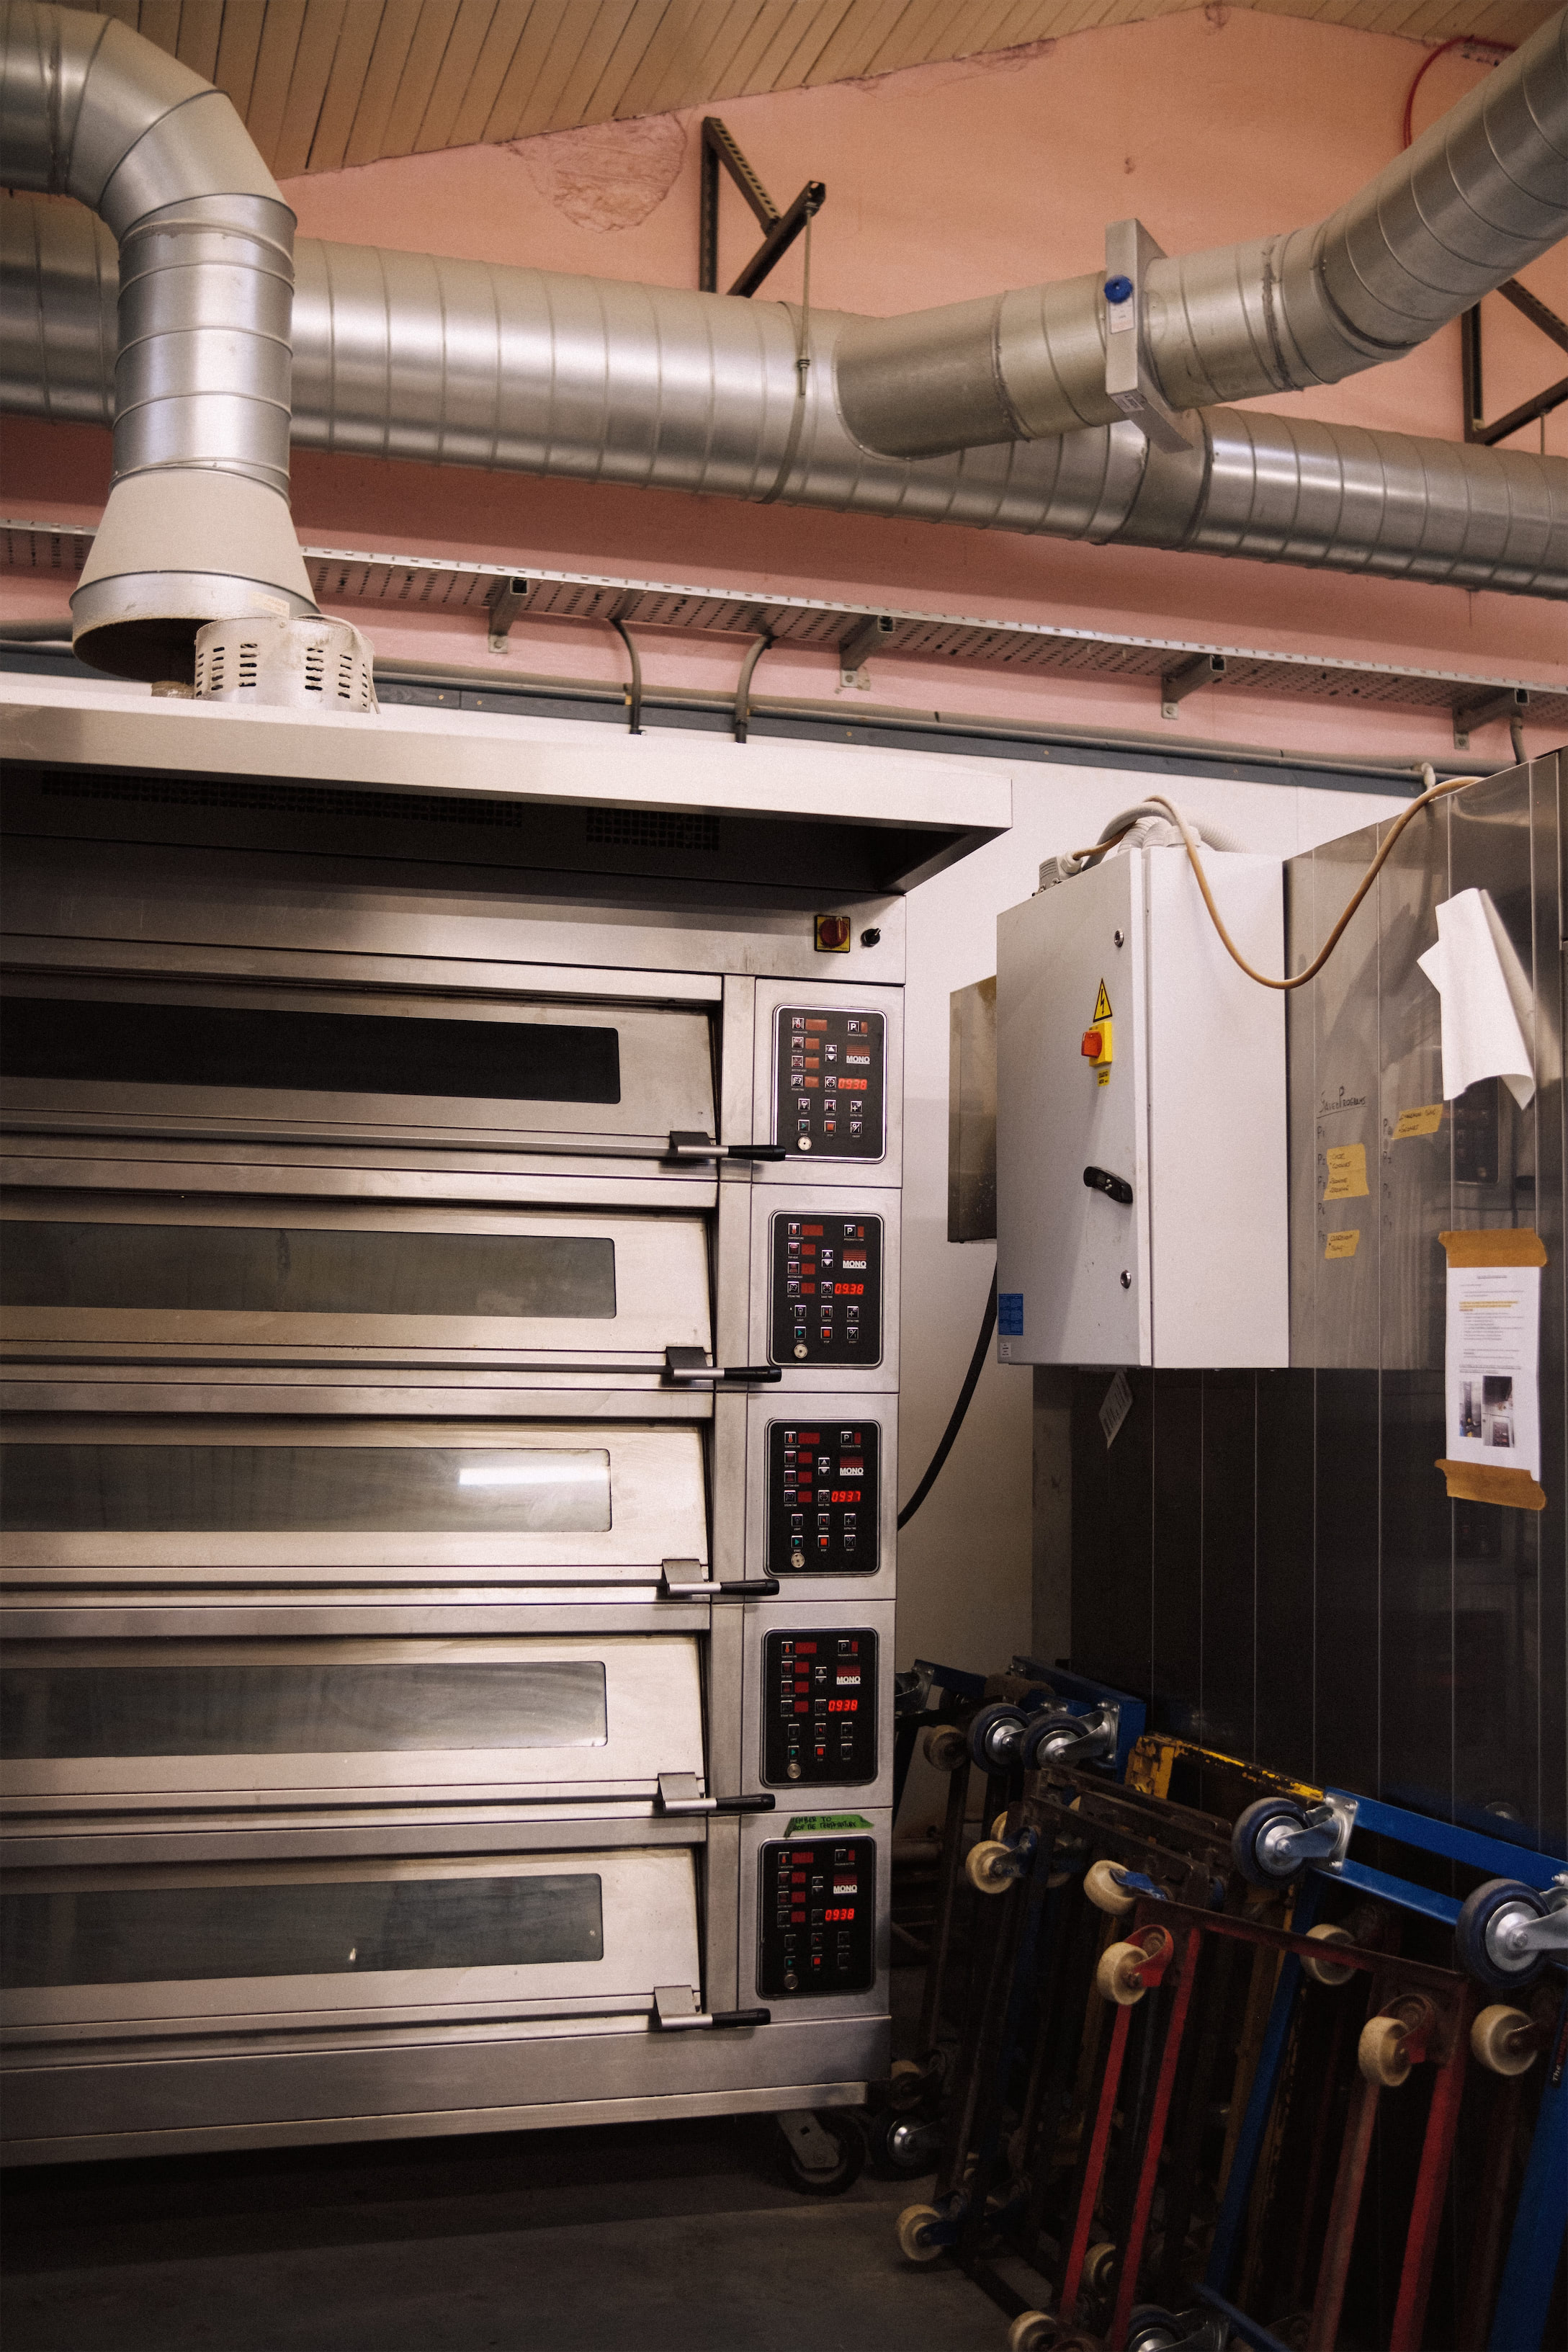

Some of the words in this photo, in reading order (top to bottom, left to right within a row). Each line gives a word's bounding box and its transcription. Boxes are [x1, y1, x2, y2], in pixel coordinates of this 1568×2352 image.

[846, 1055, 870, 1064] MONO
[843, 1260, 866, 1269] MONO
[839, 1467, 864, 1476] MONO
[837, 1676, 861, 1685] MONO
[833, 1884, 858, 1894] MONO
[1553, 2064, 1562, 2082] The
